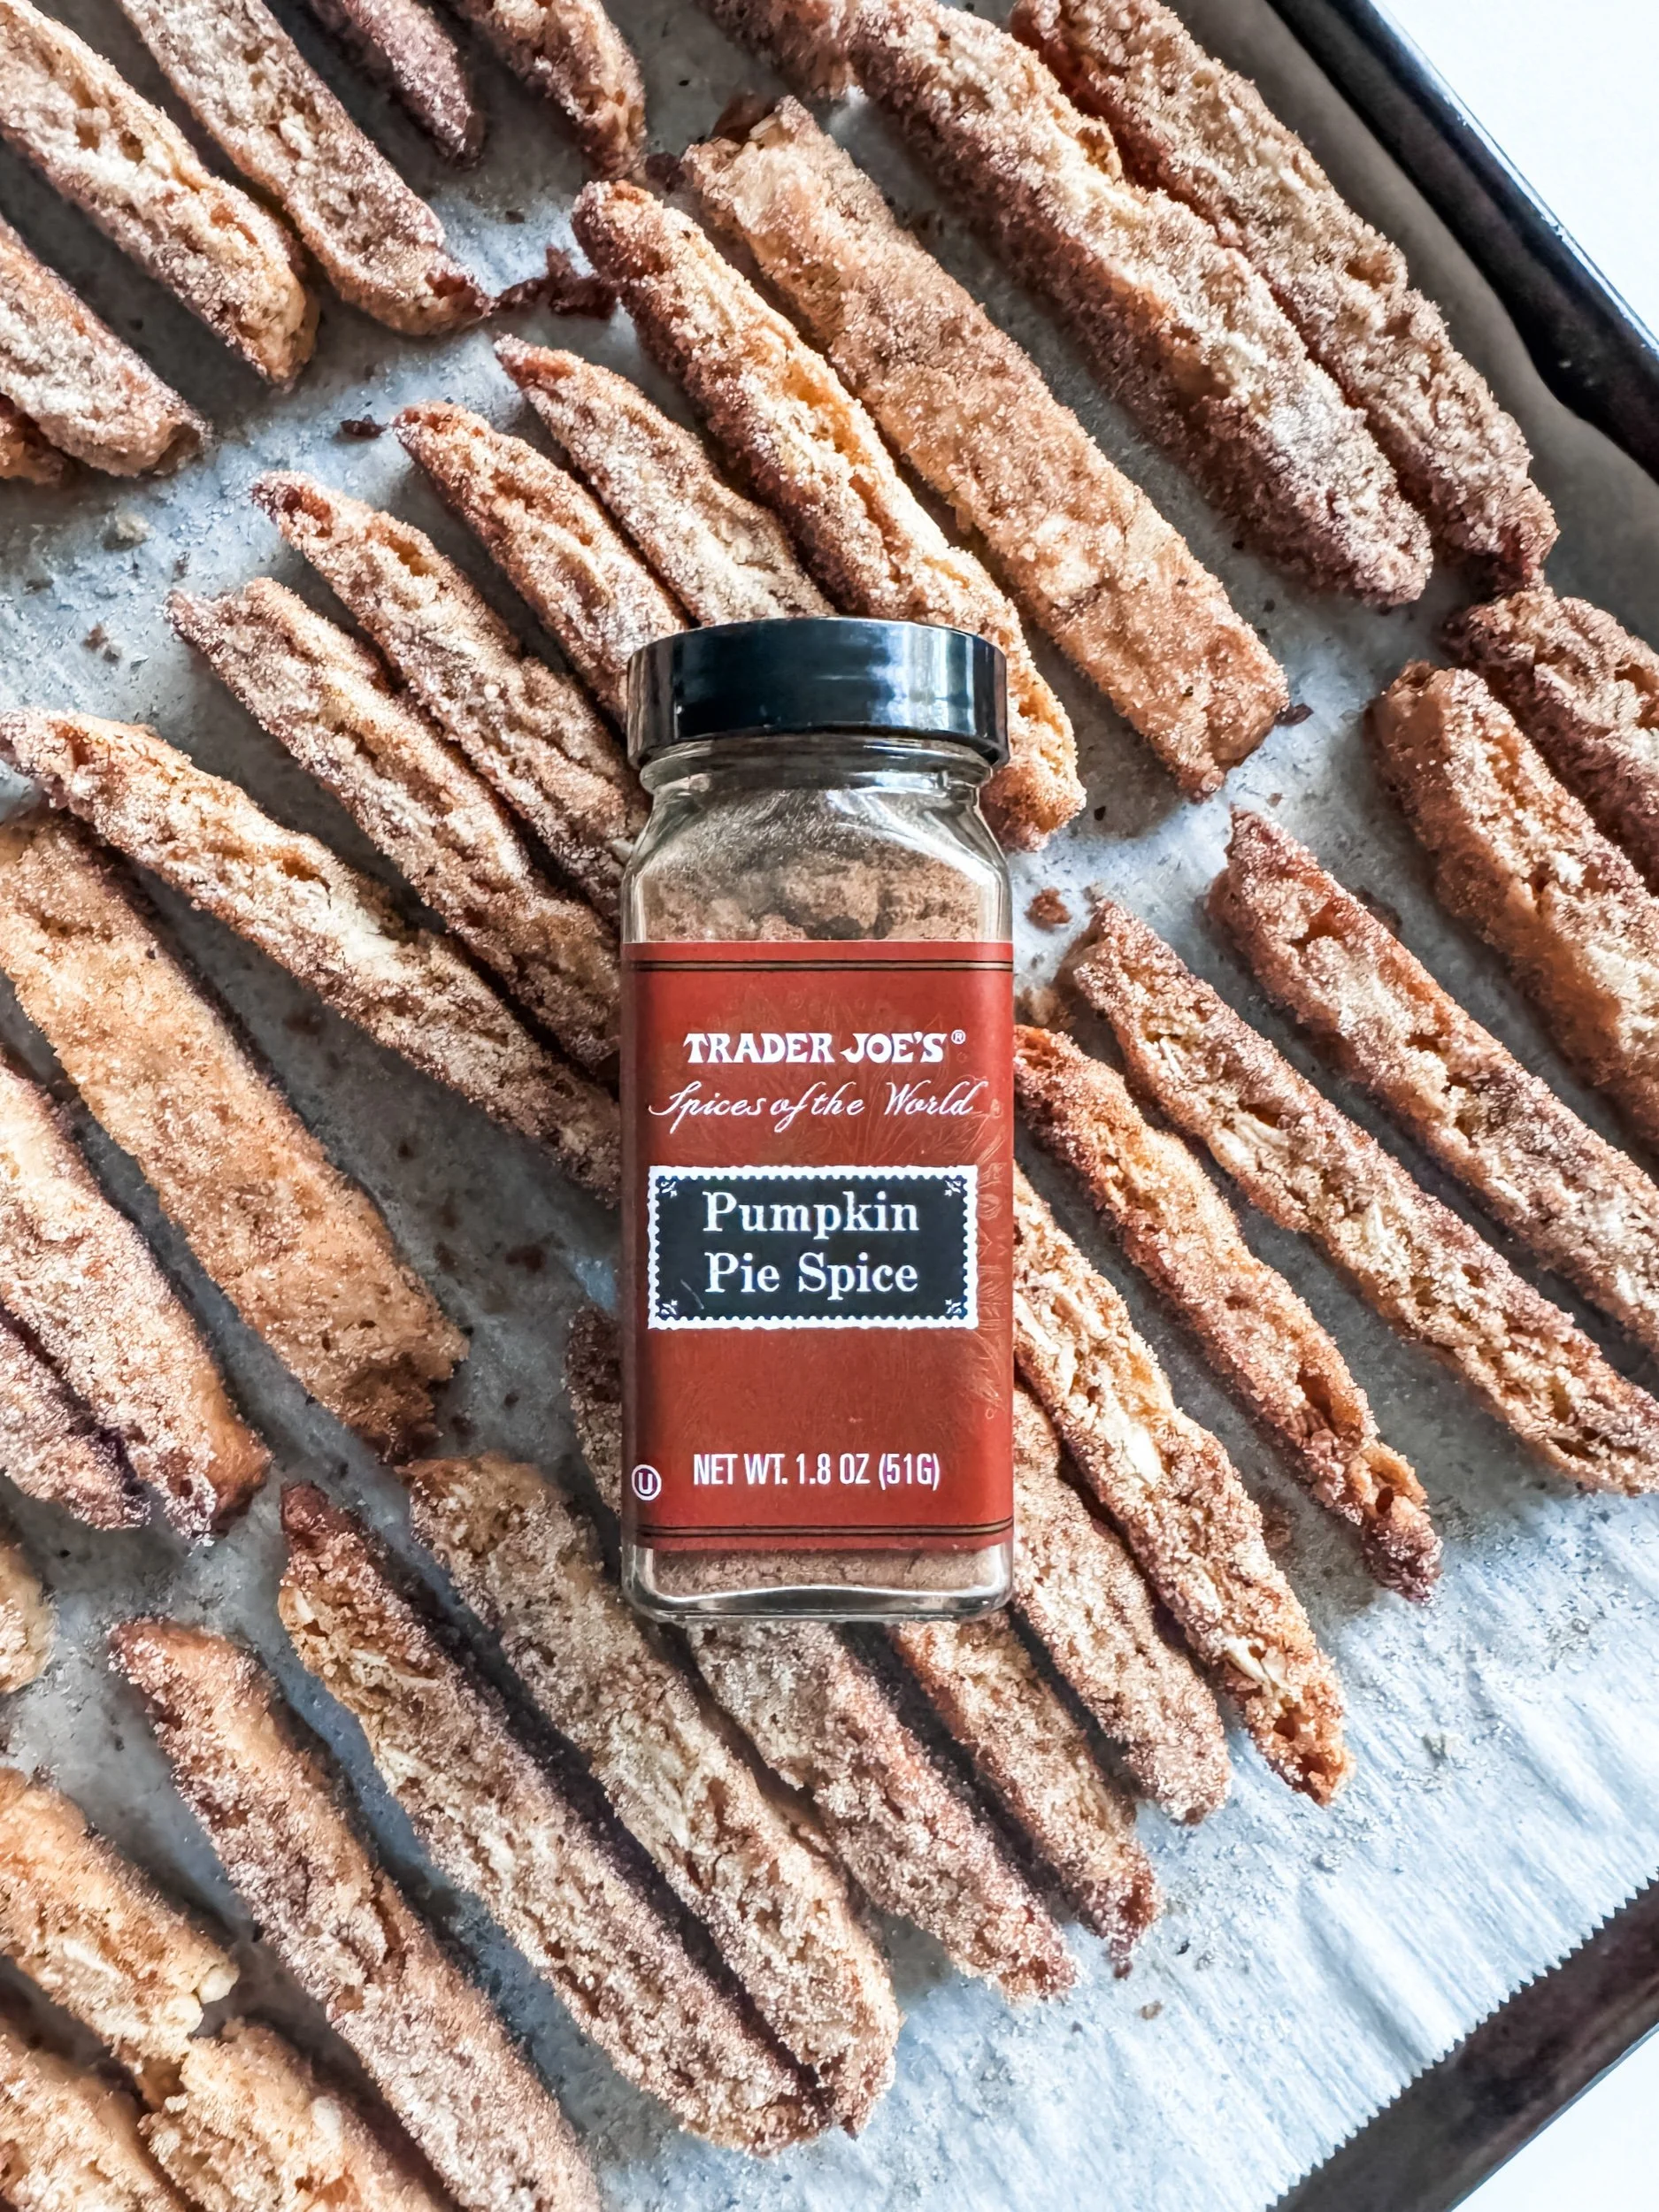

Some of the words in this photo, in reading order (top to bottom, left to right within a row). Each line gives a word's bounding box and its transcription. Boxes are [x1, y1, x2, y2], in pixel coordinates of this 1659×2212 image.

[682, 1032, 835, 1064] TRADER
[648, 1080, 766, 1134] Spices
[770, 1081, 827, 1133] of
[810, 1081, 865, 1116] the
[883, 1080, 989, 1117] World
[702, 1190, 919, 1240] Pumpkin
[703, 1252, 780, 1294] Pie
[797, 1251, 918, 1301] Spice
[693, 1453, 738, 1486] NET
[744, 1453, 788, 1486] WT.
[795, 1452, 831, 1486] 1.8
[839, 1453, 871, 1486] OZ
[878, 1452, 941, 1491] (51G)
